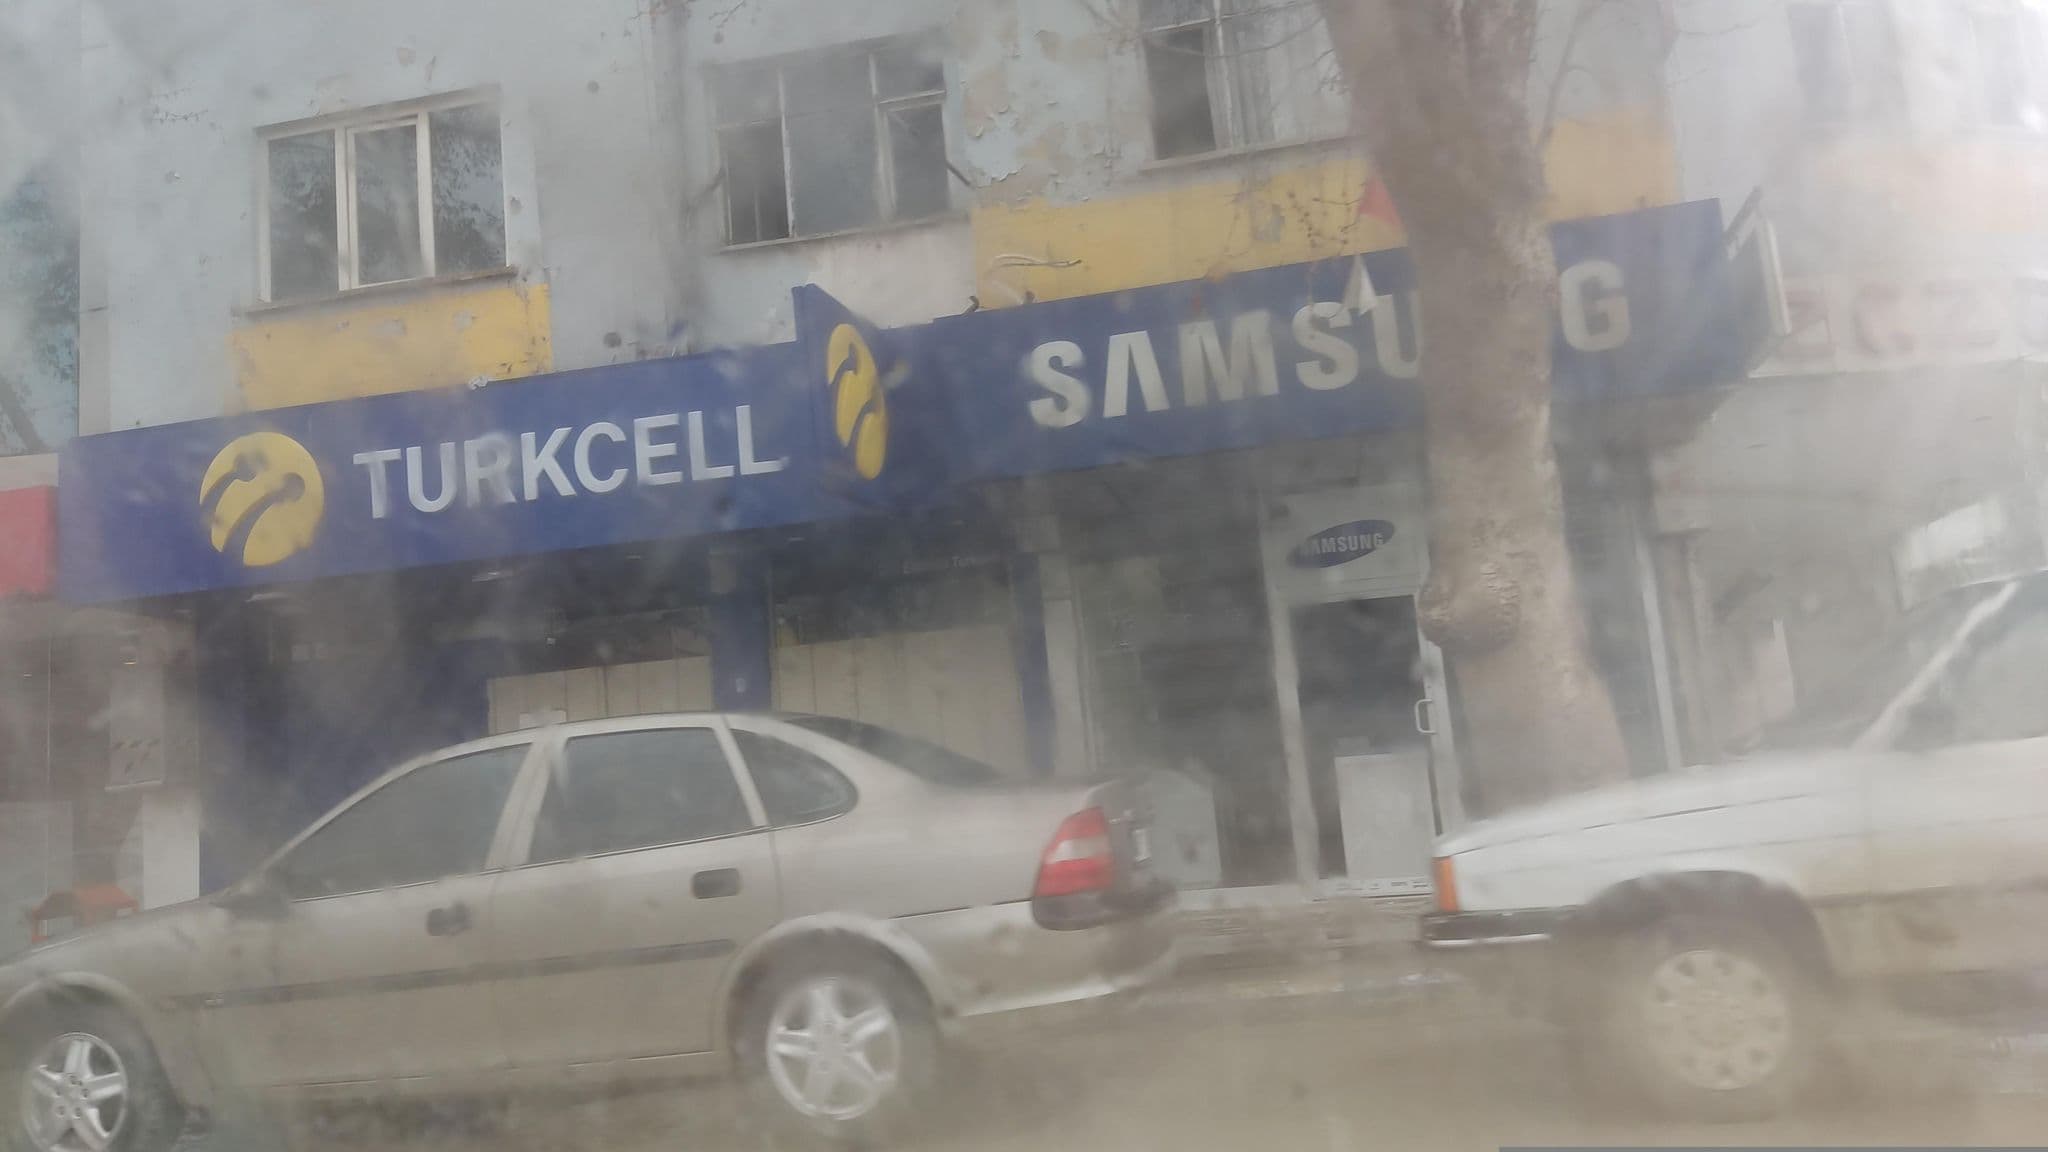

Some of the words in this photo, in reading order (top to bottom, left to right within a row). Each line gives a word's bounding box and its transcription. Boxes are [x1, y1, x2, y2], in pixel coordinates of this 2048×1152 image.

[1028, 261, 1632, 428] SAMSUG
[353, 395, 787, 519] TURKCELL
[1300, 532, 1384, 556] AMSUNG
